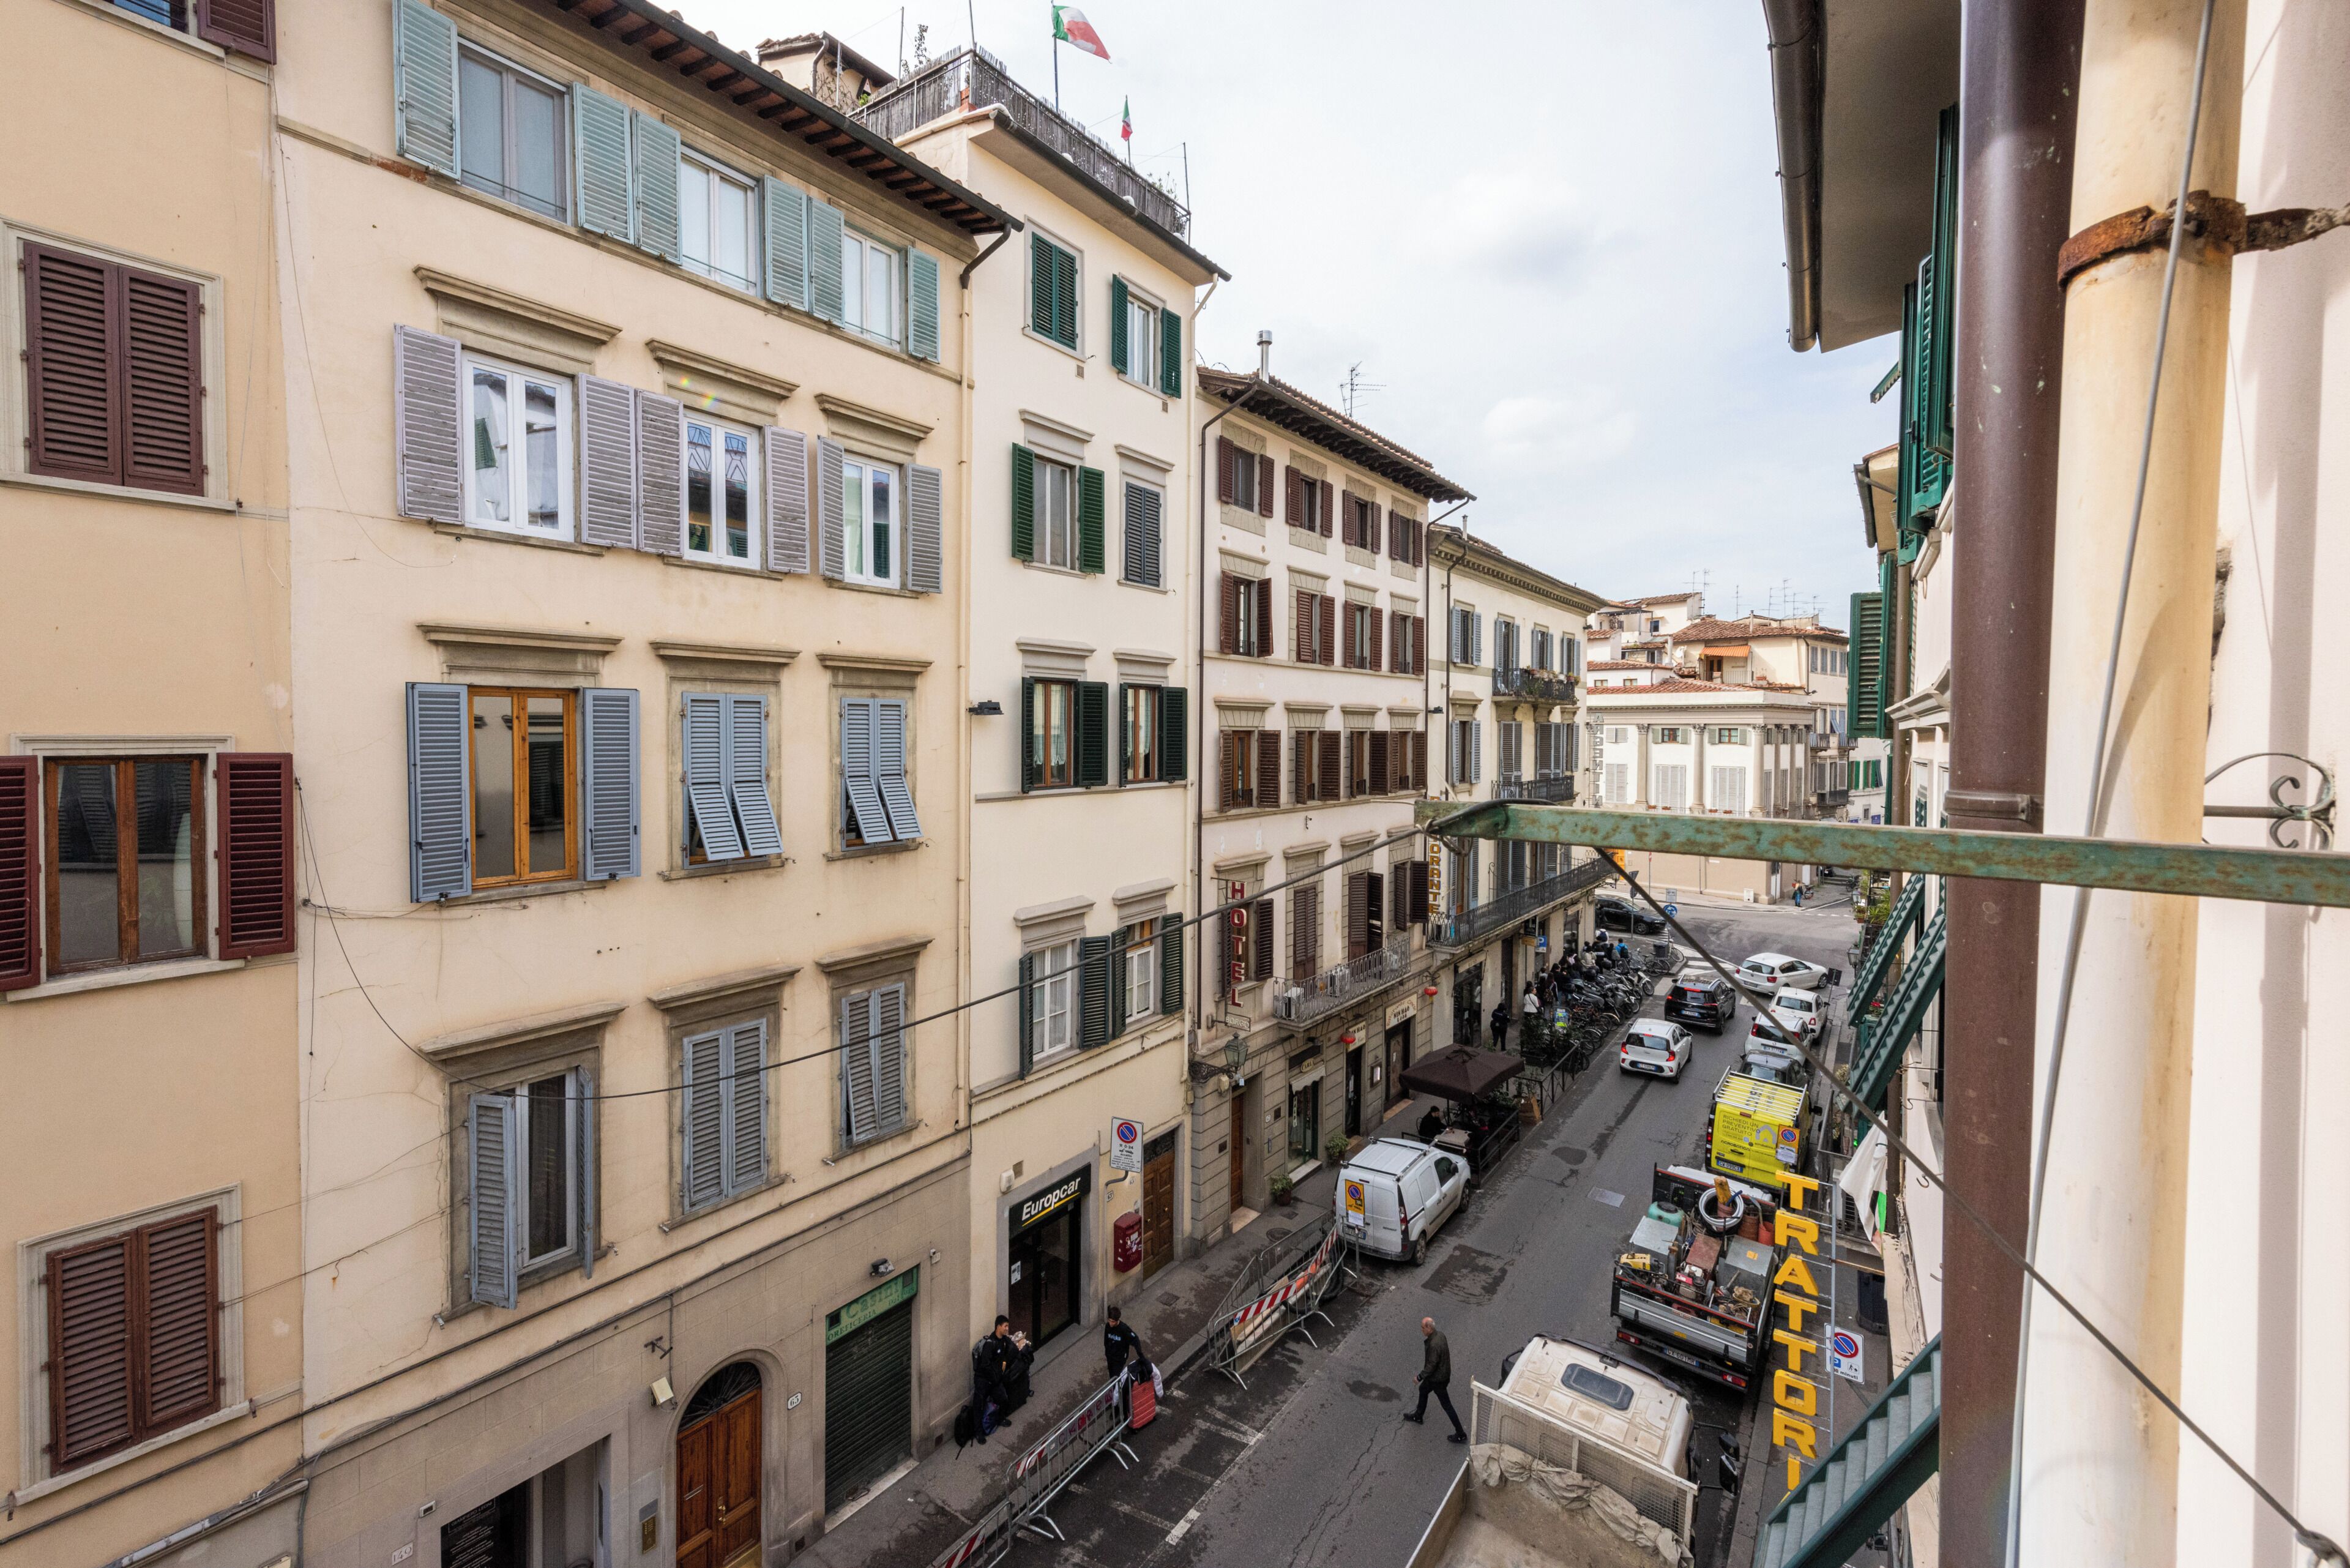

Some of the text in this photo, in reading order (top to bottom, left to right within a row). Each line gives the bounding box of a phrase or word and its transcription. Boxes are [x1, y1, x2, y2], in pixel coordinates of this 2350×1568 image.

[1230, 881, 1247, 1008] HOTEL
[1225, 1017, 1250, 1028] BORGO
[1723, 1114, 1748, 1125] RICHIEDI
[1723, 1119, 1761, 1133] PREVENTIVO
[1722, 1124, 1752, 1137] GRATUITO
[1021, 1177, 1081, 1221] Europcar
[827, 1309, 877, 1342] OREFICERIA
[1774, 1169, 1819, 1504] TRATTORI
[1840, 1371, 1858, 1380] minuti
[790, 1395, 799, 1406] 65
